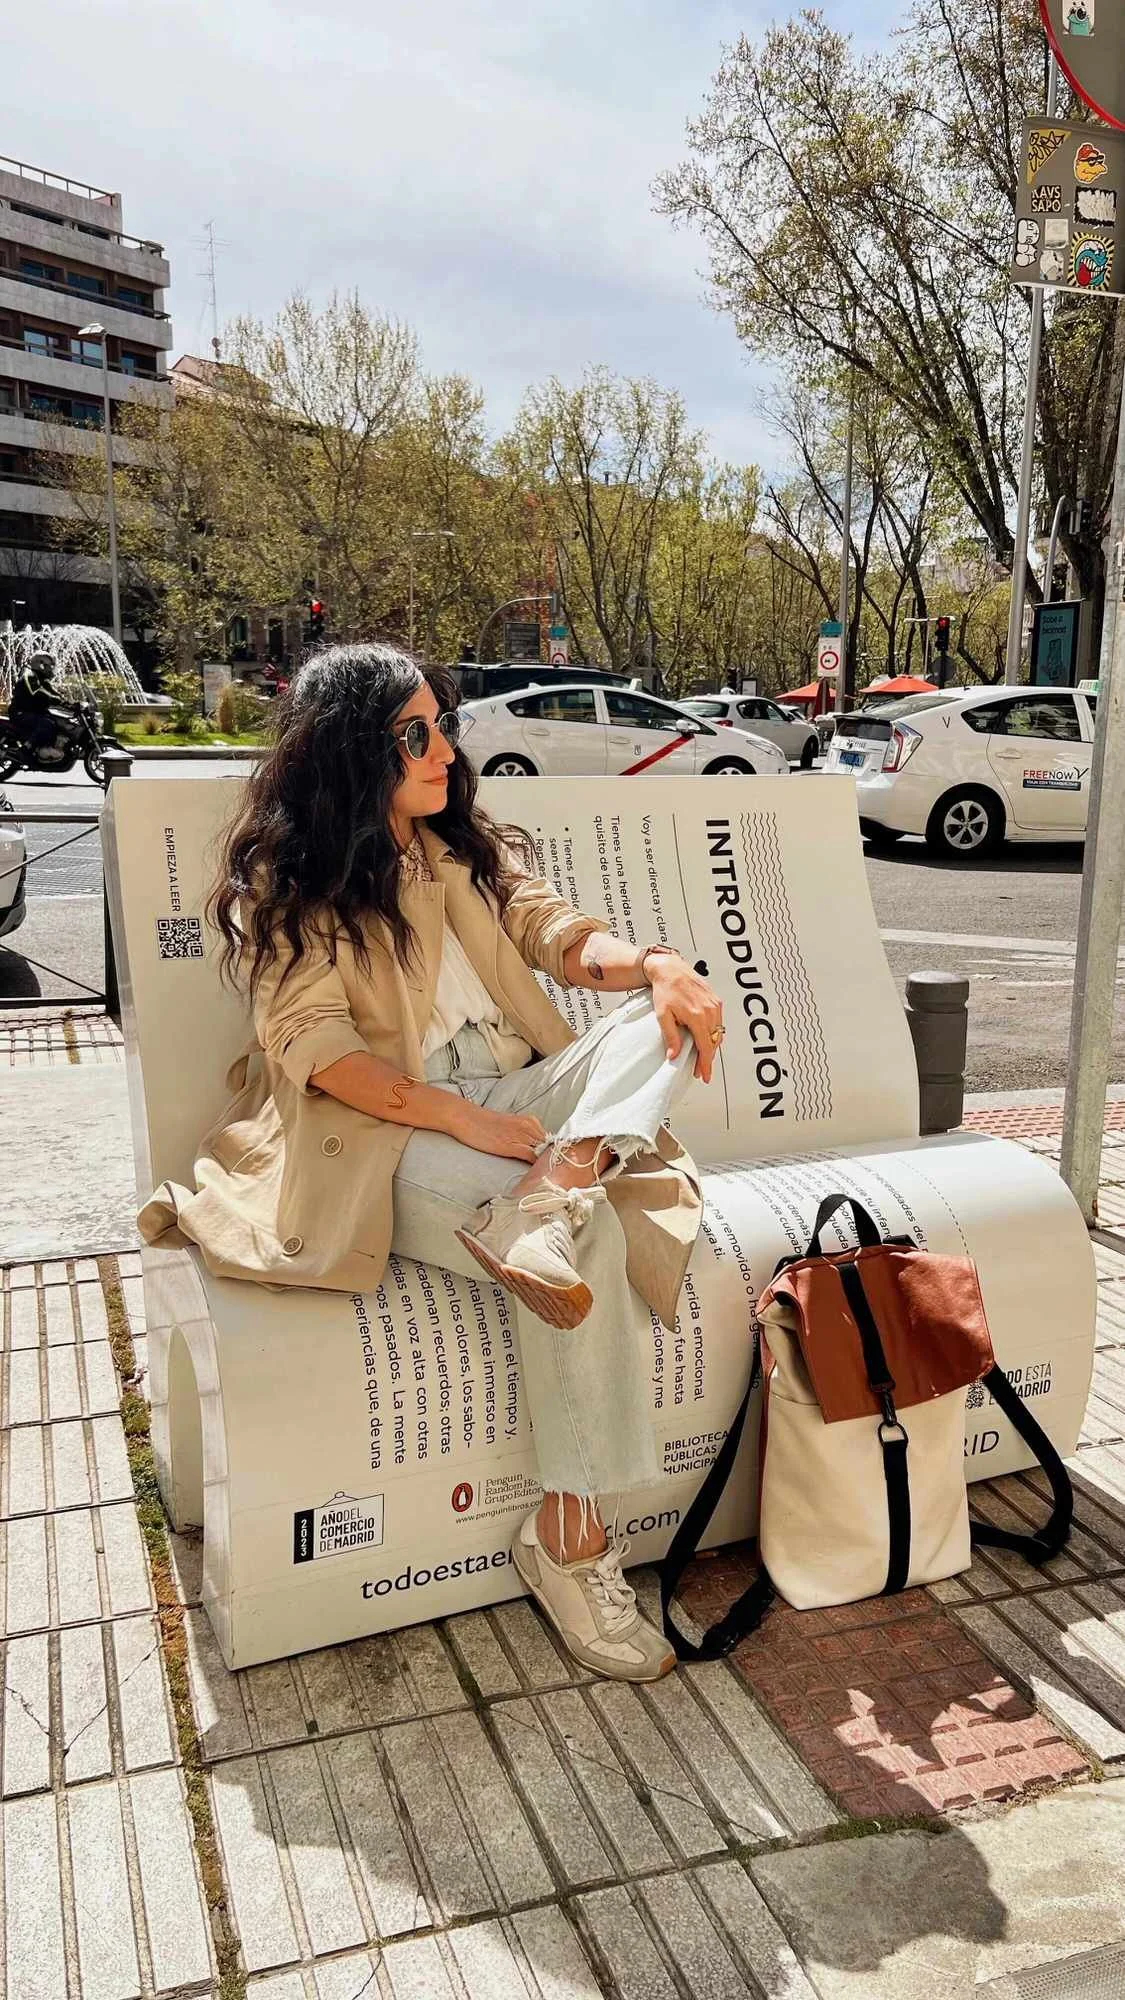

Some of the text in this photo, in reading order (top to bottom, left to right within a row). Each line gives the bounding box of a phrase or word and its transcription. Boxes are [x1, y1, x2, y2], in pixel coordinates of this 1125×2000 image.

[1032, 200, 1061, 212] SAPO
[593, 815, 606, 854] quisito
[610, 816, 621, 852] Tienes
[641, 814, 651, 836] Voy
[165, 828, 177, 873] EMPIEZA
[535, 838, 546, 877] Repites
[550, 838, 559, 863] sean
[563, 838, 574, 871] Tienes
[645, 848, 654, 865] ser
[553, 865, 562, 878] de
[600, 857, 609, 871] de
[615, 856, 624, 877] una
[553, 881, 563, 897] par
[566, 876, 579, 909] proble
[602, 874, 610, 891] los
[648, 867, 661, 905] directa
[170, 885, 181, 912] LEER
[603, 893, 615, 914] que
[619, 881, 632, 916] herida
[625, 920, 637, 945] emo
[656, 916, 668, 942] clara
[705, 820, 788, 1119] INTRODUCCIÓN
[545, 974, 558, 1009] relacio
[780, 1216, 802, 1254] culpab
[913, 1225, 927, 1244] del
[720, 1222, 751, 1281] removido
[746, 1286, 753, 1295] o
[442, 1272, 456, 1297] son
[401, 1294, 413, 1313] en
[449, 1299, 462, 1322] los
[493, 1288, 510, 1326] atrás
[407, 1316, 420, 1344] voz
[502, 1329, 513, 1349] en
[684, 1272, 706, 1402] herida emocional
[378, 1314, 402, 1385] pasados.
[413, 1260, 440, 1326] ncadenan
[440, 1416, 453, 1455] otras
[455, 1324, 471, 1377] olores,
[466, 1277, 496, 1445] ntalmente inmerso en
[505, 1353, 518, 1369] el
[674, 1337, 686, 1362] fue
[412, 1349, 426, 1381] alta
[1007, 1360, 1052, 1384] DO ESTÁ
[462, 1379, 475, 1404] los
[652, 1375, 663, 1384] y
[674, 1365, 687, 1405] hasta
[1016, 1380, 1051, 1398] ADRID
[393, 1390, 406, 1410] La
[416, 1387, 427, 1416] con
[505, 1372, 519, 1425] tiempo
[654, 1387, 664, 1409] me
[370, 1417, 383, 1438] de
[394, 1415, 407, 1465] mente
[418, 1420, 430, 1460] otras
[664, 1444, 717, 1464] PÚBLICAS
[665, 1431, 728, 1452] BIBLIOTECA
[371, 1440, 381, 1470] una
[485, 1478, 539, 1497] Random Ho
[486, 1473, 523, 1488] Penguin
[484, 1491, 514, 1505] Grupo
[320, 1517, 375, 1539] COMERCIO
